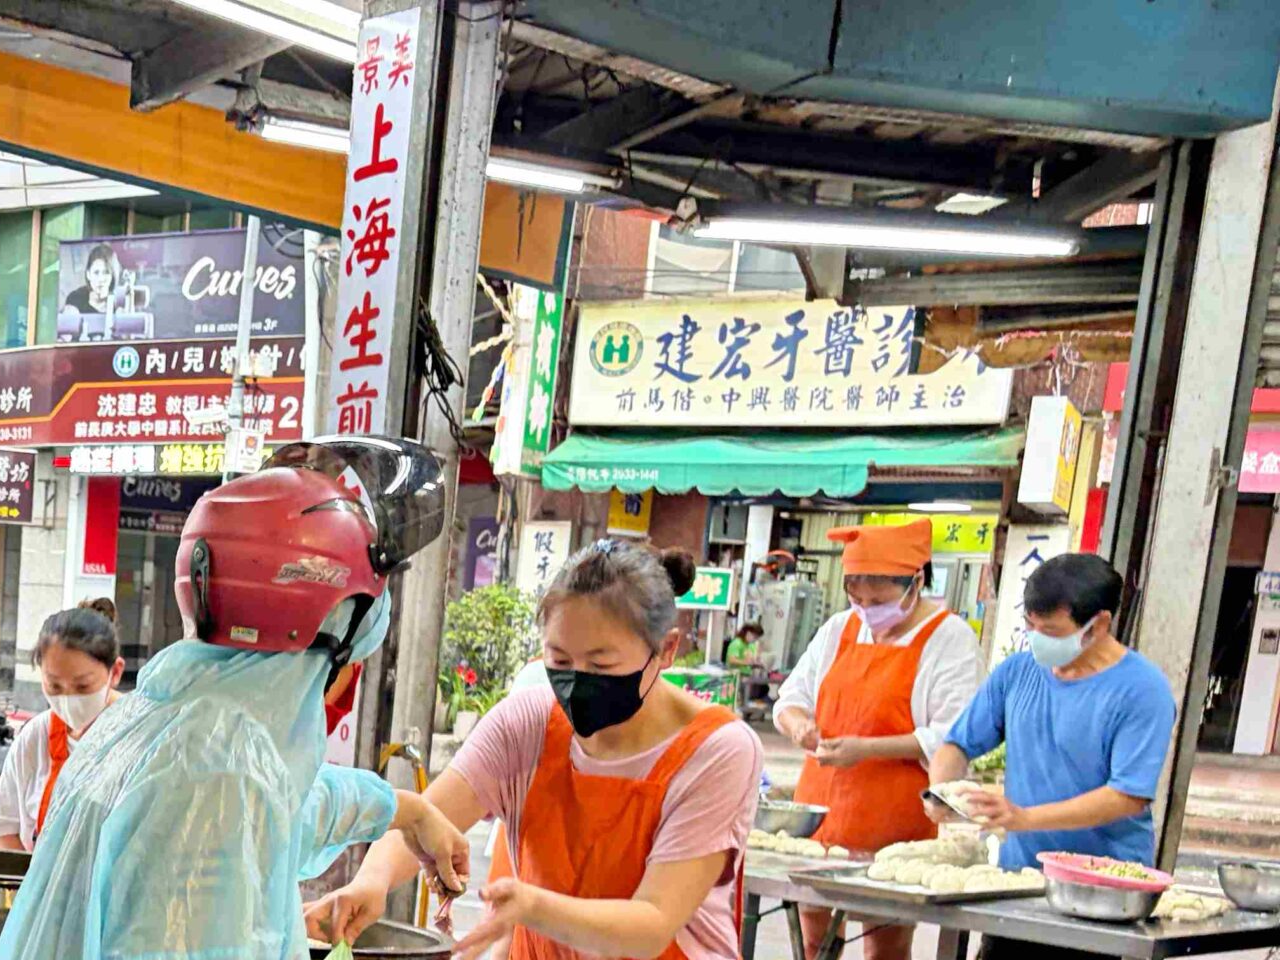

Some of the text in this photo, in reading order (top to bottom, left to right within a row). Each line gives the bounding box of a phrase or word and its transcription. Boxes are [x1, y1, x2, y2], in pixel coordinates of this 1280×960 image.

[358, 31, 414, 96] 景美
[336, 102, 400, 435] 上海生前
[652, 306, 986, 383] 建宏牙醫診
[97, 392, 157, 417] 沈建忠
